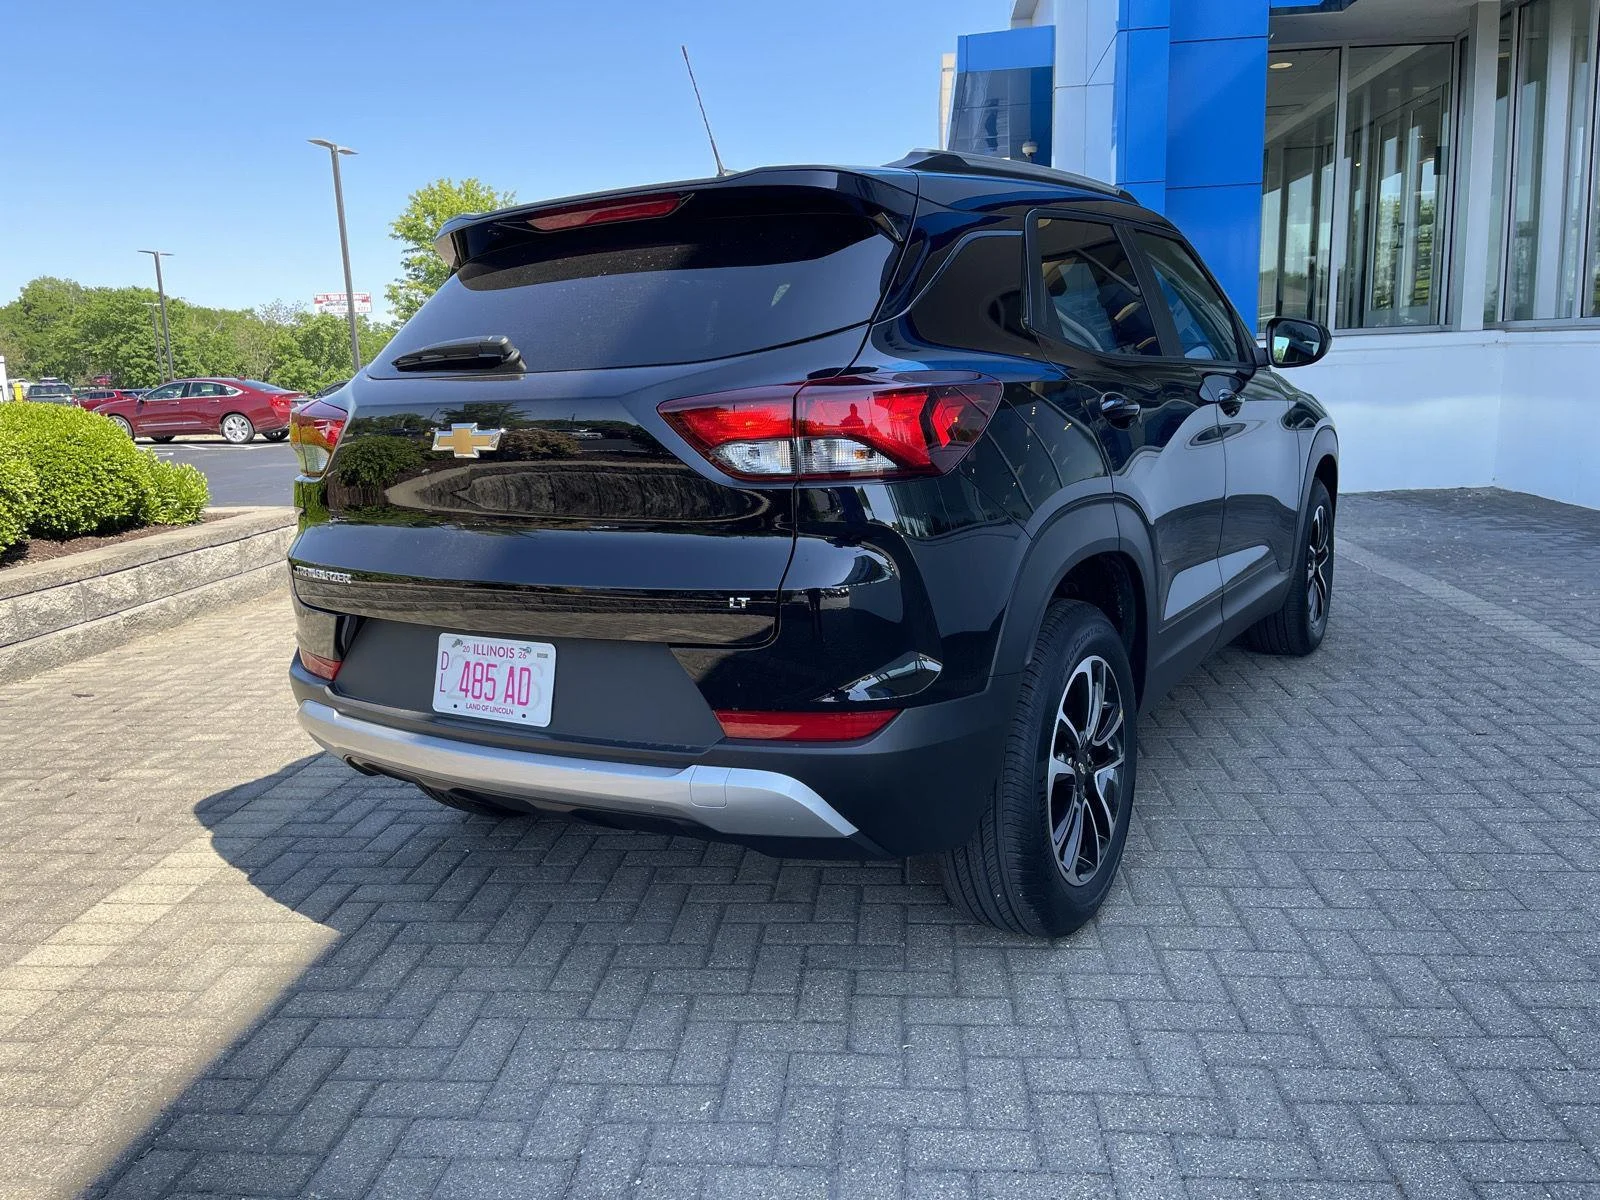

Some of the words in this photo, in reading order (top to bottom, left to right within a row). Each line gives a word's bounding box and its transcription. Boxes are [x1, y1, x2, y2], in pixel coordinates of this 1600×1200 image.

[729, 597, 751, 609] LT
[462, 645, 471, 653] 20
[473, 643, 515, 659] ILLINOIS
[518, 651, 527, 659] 26
[459, 660, 498, 702] 485
[503, 665, 532, 707] AD
[465, 702, 481, 711] LAND
[490, 706, 514, 715] LINCOLN
